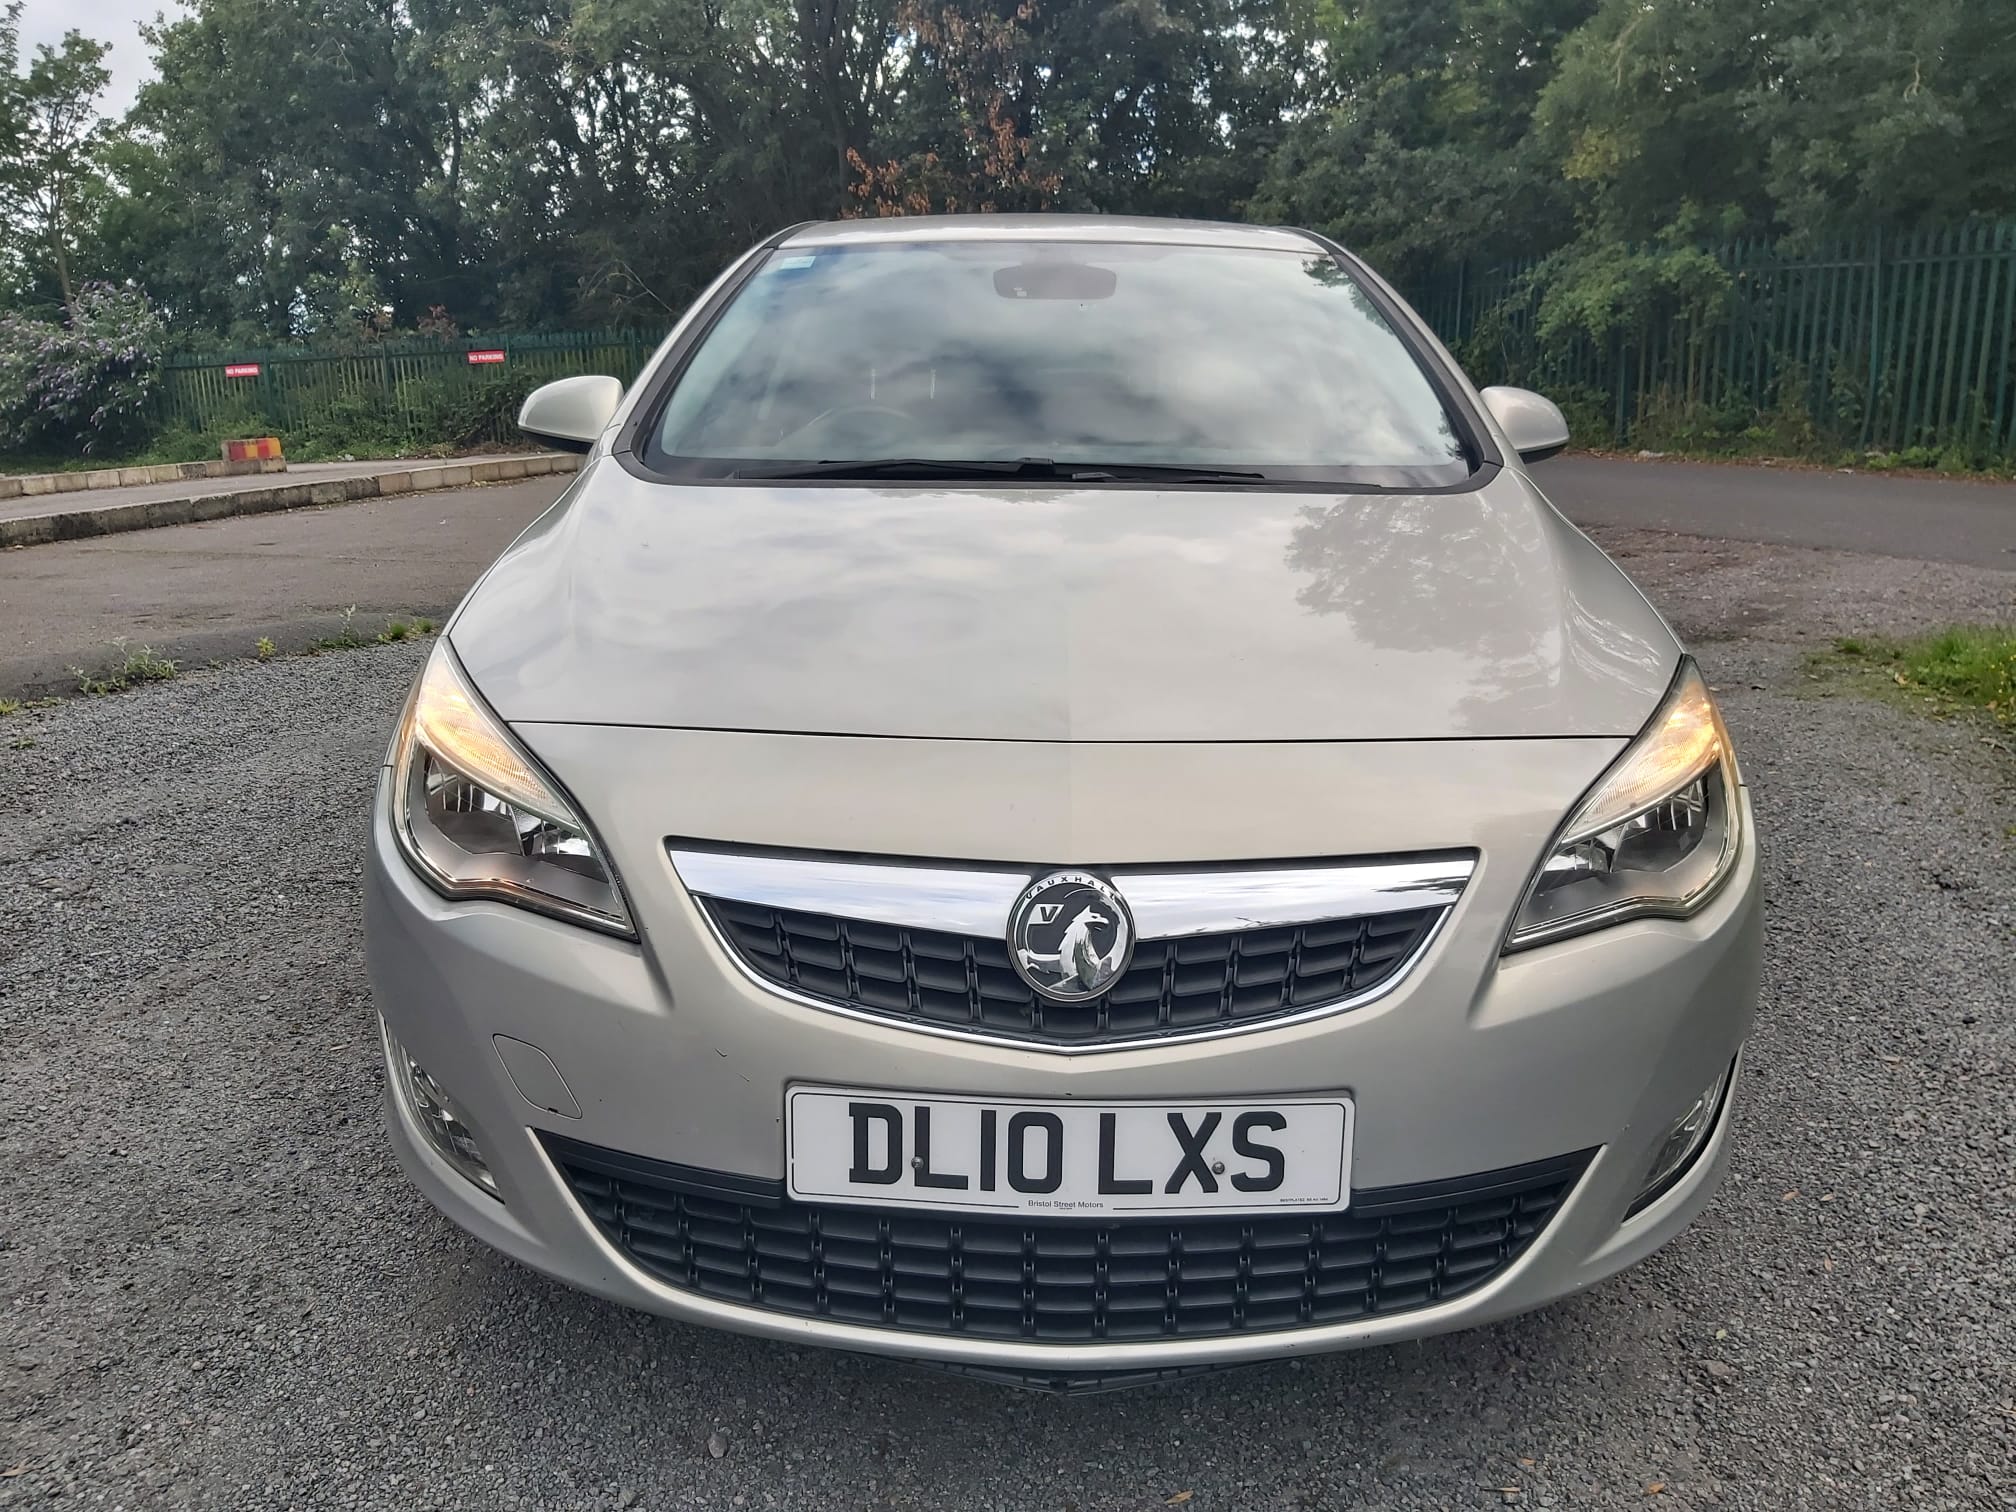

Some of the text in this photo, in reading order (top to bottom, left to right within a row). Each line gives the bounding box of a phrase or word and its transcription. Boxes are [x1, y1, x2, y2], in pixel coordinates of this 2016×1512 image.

[1025, 876, 1116, 901] VAUXHALL
[849, 1102, 1287, 1194] DL10 LXS
